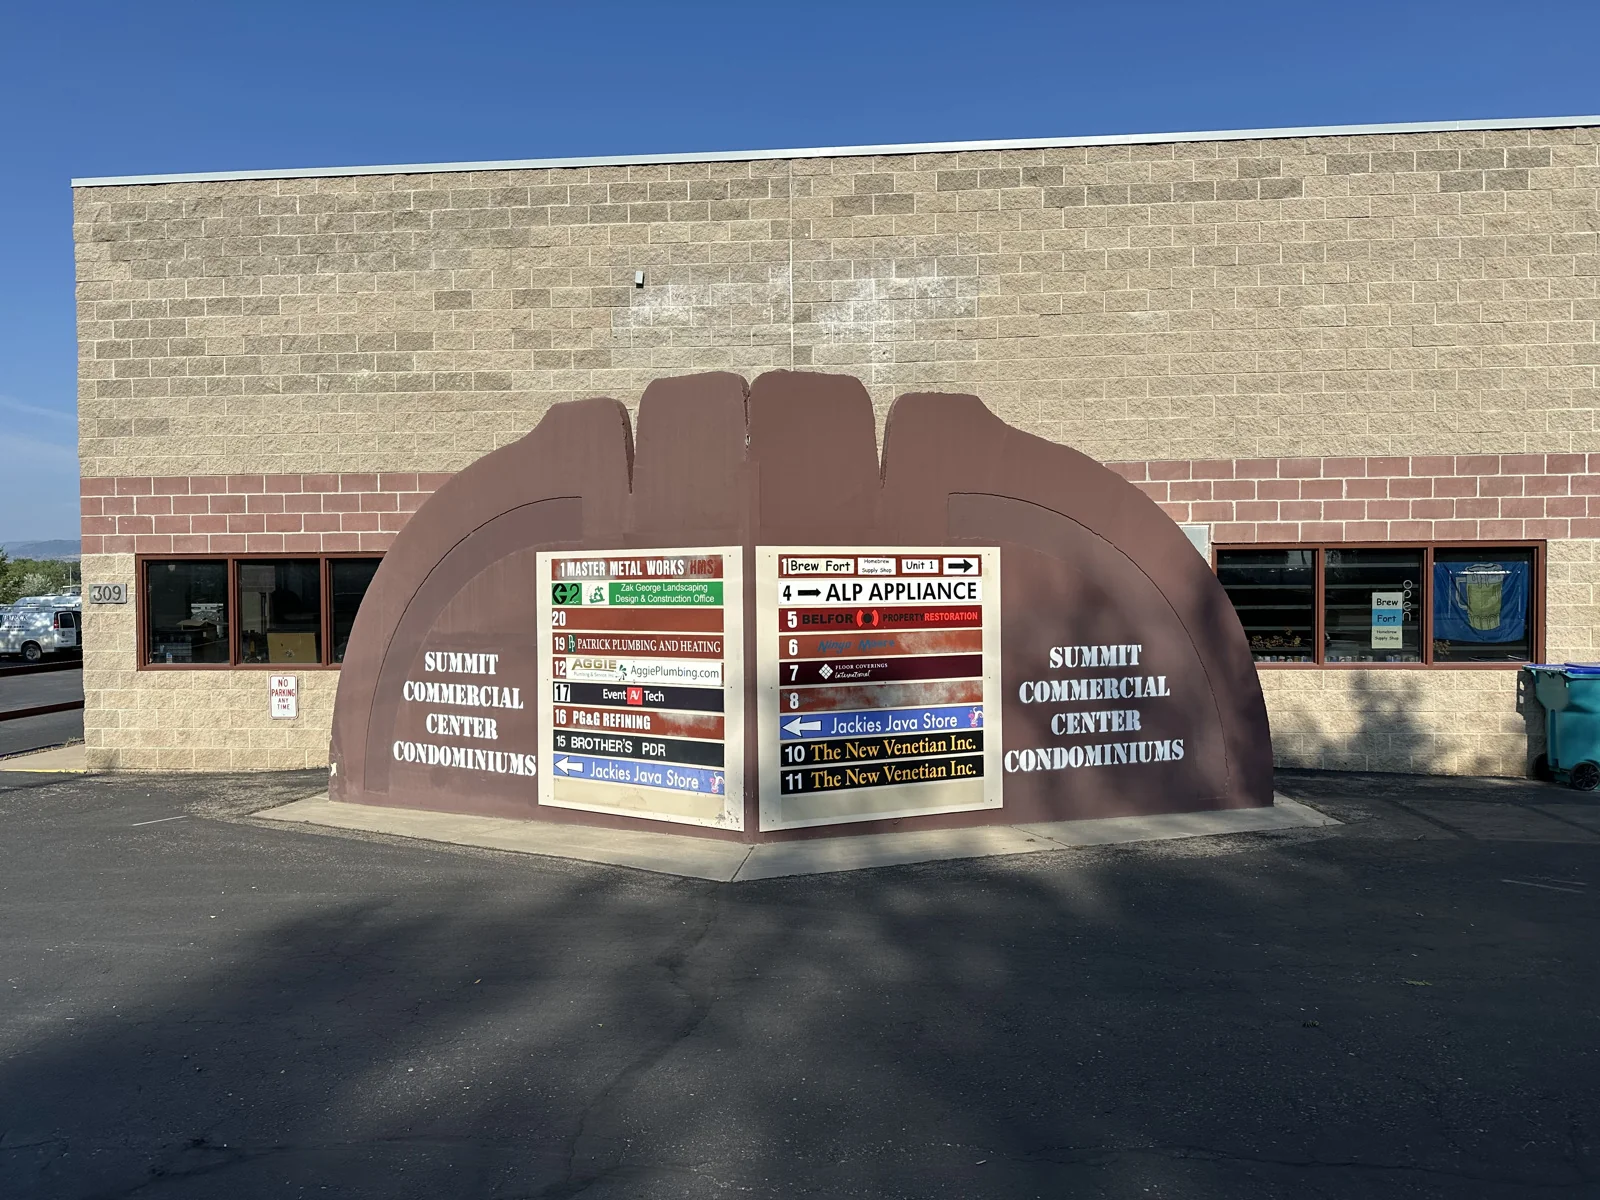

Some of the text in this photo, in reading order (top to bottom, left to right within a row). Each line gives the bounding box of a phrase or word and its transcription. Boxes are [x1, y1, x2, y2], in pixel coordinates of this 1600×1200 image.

[561, 562, 565, 577] 1
[567, 561, 605, 576] MASTER
[610, 560, 642, 576] METAL
[646, 560, 684, 574] WORKS
[790, 561, 819, 572] Brew
[826, 561, 851, 572] Fort
[906, 561, 933, 570] Unit 1
[94, 586, 121, 601] 309
[636, 584, 661, 593] George
[663, 583, 707, 593] Landscaping
[783, 582, 977, 601] 4 ALP APPLIANCE
[616, 595, 638, 604] Design
[1403, 580, 1412, 621] open
[552, 611, 566, 626] 20
[787, 611, 978, 628] 5 BELFOR PROPERTY RESTORATION
[555, 637, 565, 650] 19
[577, 639, 610, 650] PATRICK
[613, 640, 656, 652] PLUMBING
[659, 640, 679, 651] AND
[680, 641, 721, 653] HEATING
[788, 639, 798, 656] 6
[425, 651, 498, 674] SUMMIT
[1050, 645, 1141, 668] SUMMIT
[555, 659, 616, 676] 12 AGGIE
[631, 665, 719, 679] AggiePlumbing.com
[790, 665, 799, 681] 7
[278, 679, 288, 687] NO
[1019, 676, 1170, 704] COMMERCIAL
[403, 680, 524, 709] COMMERCIAL
[555, 685, 664, 702] 17 Event AV Tech
[790, 692, 799, 709] 8
[426, 713, 498, 739] CENTER
[555, 709, 650, 730] 16 PG&G REFINING
[831, 713, 957, 734] Jackies Java Store
[1051, 710, 1141, 735] CENTER
[556, 735, 666, 756] 15 BROTHER'S PDR
[785, 735, 976, 762] 10 The New Venetian Inc.
[393, 740, 536, 776] CONDOMINIUMS
[1004, 739, 1184, 772] CONDOMINIUMS
[590, 761, 698, 789] Jackies Java Store
[786, 760, 976, 790] 11 The New Venetian Inc.
